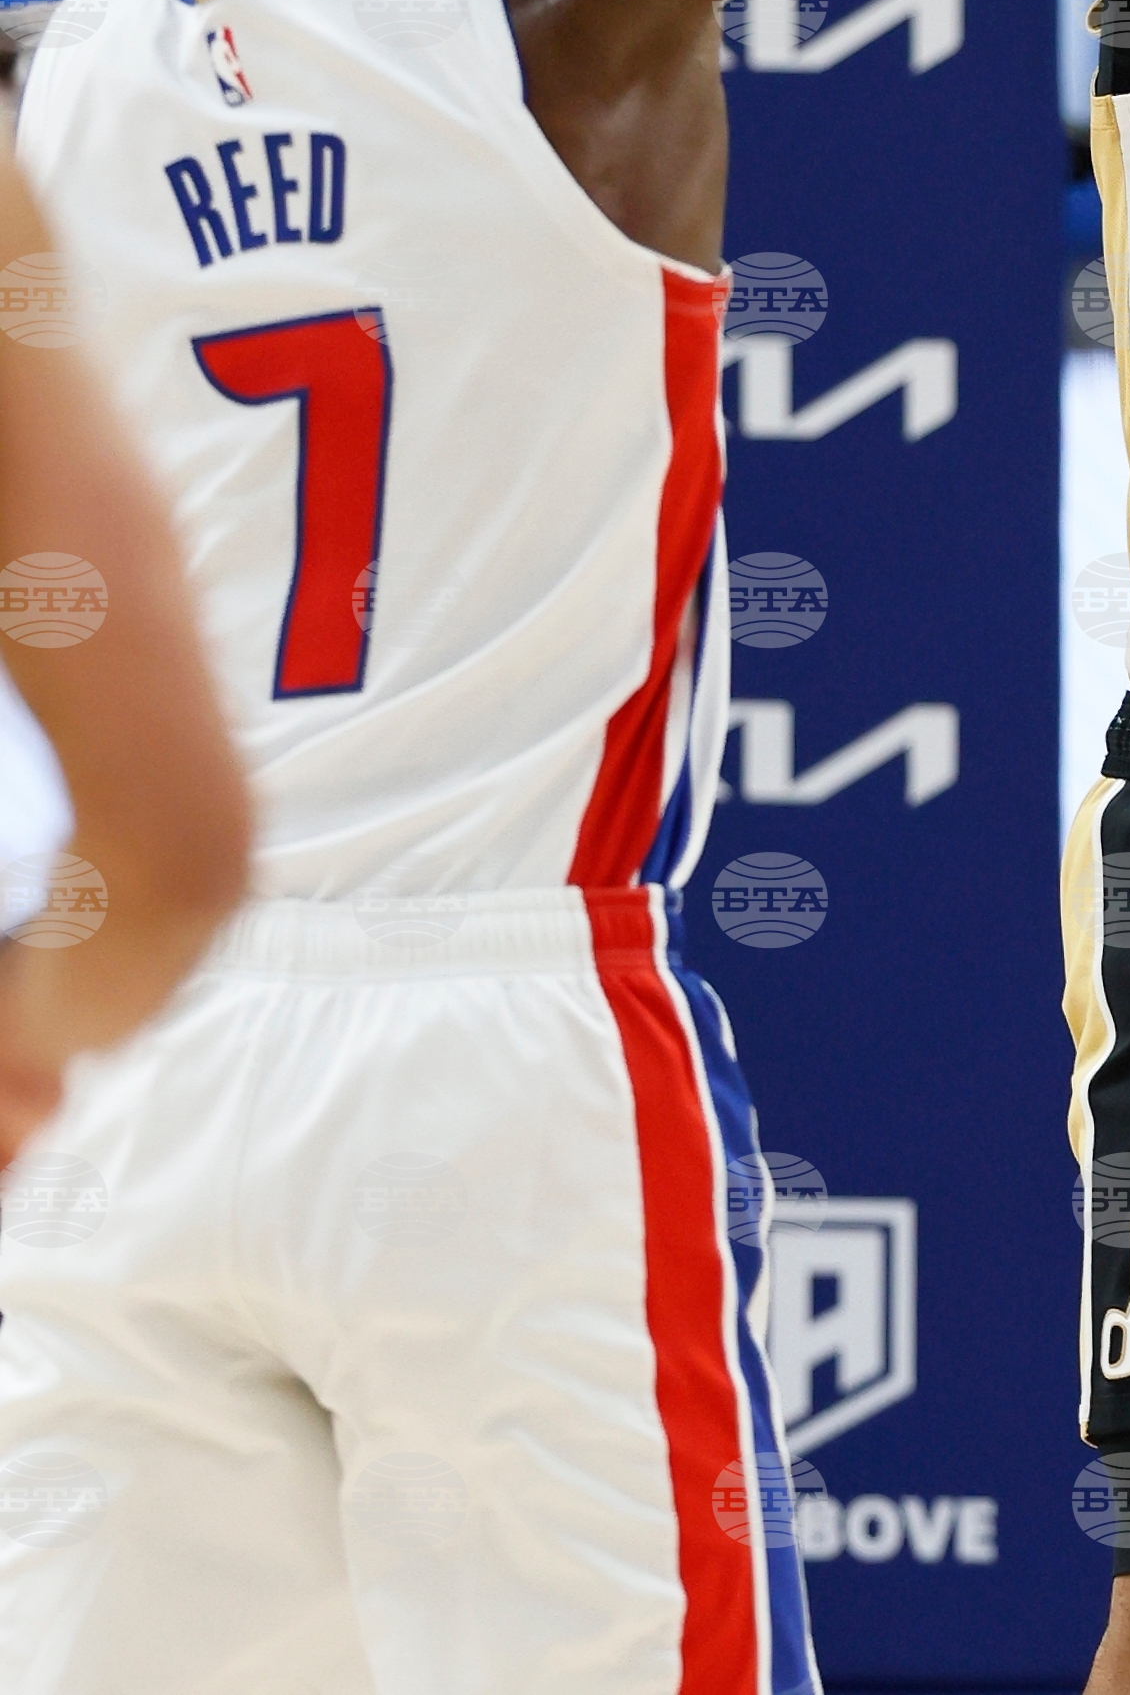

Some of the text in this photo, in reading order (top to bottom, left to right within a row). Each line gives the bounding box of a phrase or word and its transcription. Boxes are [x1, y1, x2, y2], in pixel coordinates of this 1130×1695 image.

[164, 131, 346, 270] REED
[191, 304, 393, 702] 7
[795, 1493, 999, 1565] BOVE
